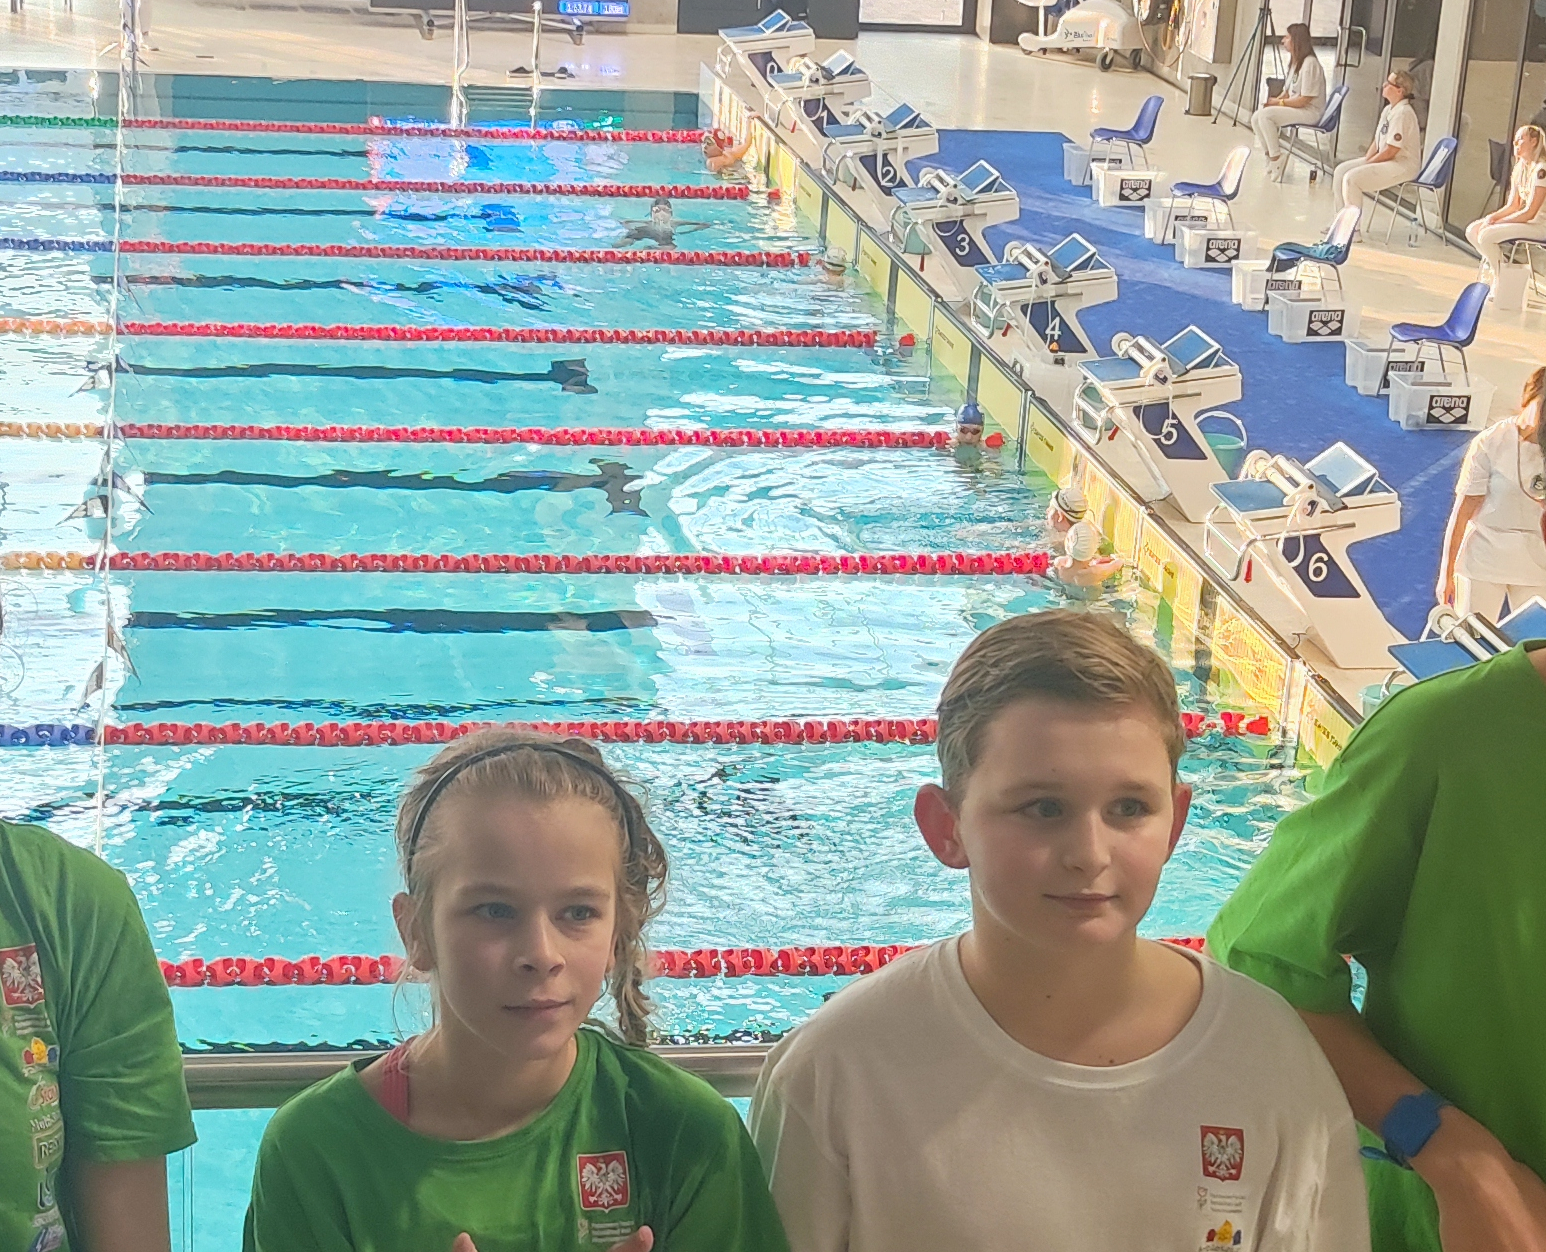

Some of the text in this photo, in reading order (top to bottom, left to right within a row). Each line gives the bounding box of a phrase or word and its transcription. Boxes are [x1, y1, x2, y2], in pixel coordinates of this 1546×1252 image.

[882, 166, 896, 186] 2
[955, 234, 970, 256] 3
[1208, 239, 1238, 249] arena
[1311, 311, 1342, 322] arena
[1045, 316, 1061, 339] 4
[1388, 362, 1422, 373] arena
[1431, 396, 1468, 408] arena
[1160, 420, 1178, 445] 5
[1308, 553, 1329, 582] 6
